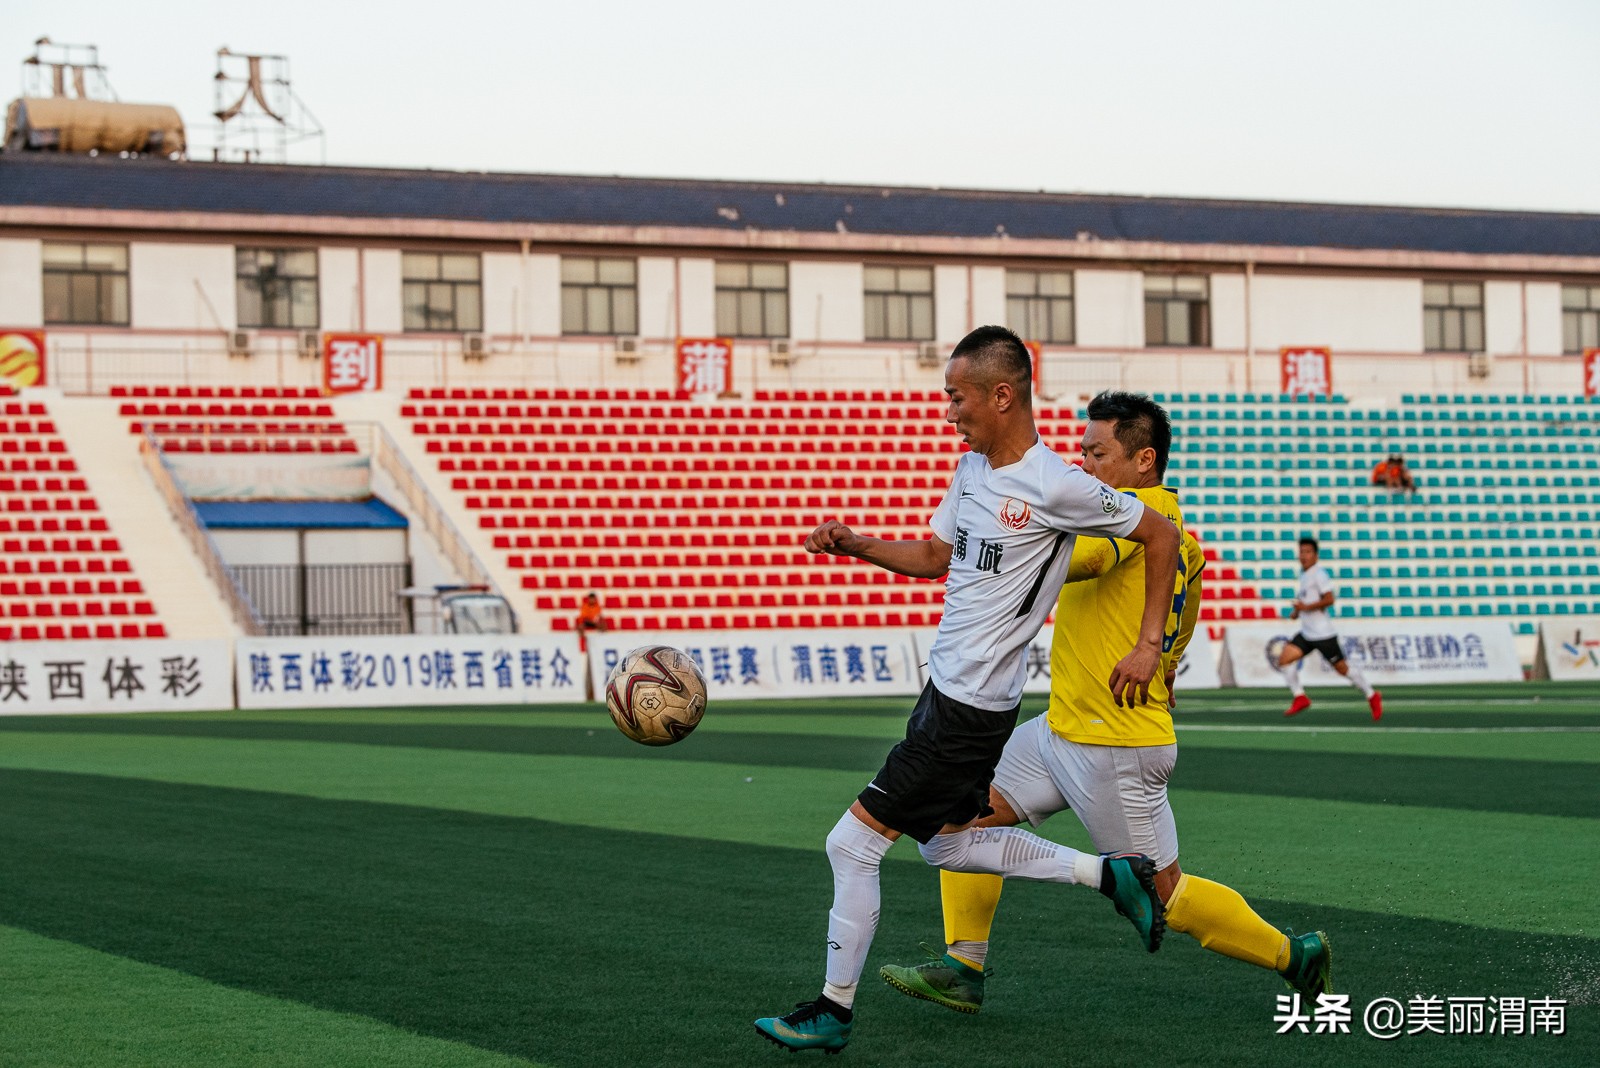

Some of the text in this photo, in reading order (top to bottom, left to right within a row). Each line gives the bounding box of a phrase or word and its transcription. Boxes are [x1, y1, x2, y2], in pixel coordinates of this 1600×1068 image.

[330, 341, 377, 391] 到
[682, 342, 727, 393] 蒲
[953, 526, 1004, 574] 蒲城
[250, 648, 574, 692] 陕西体彩2019陕西省群众
